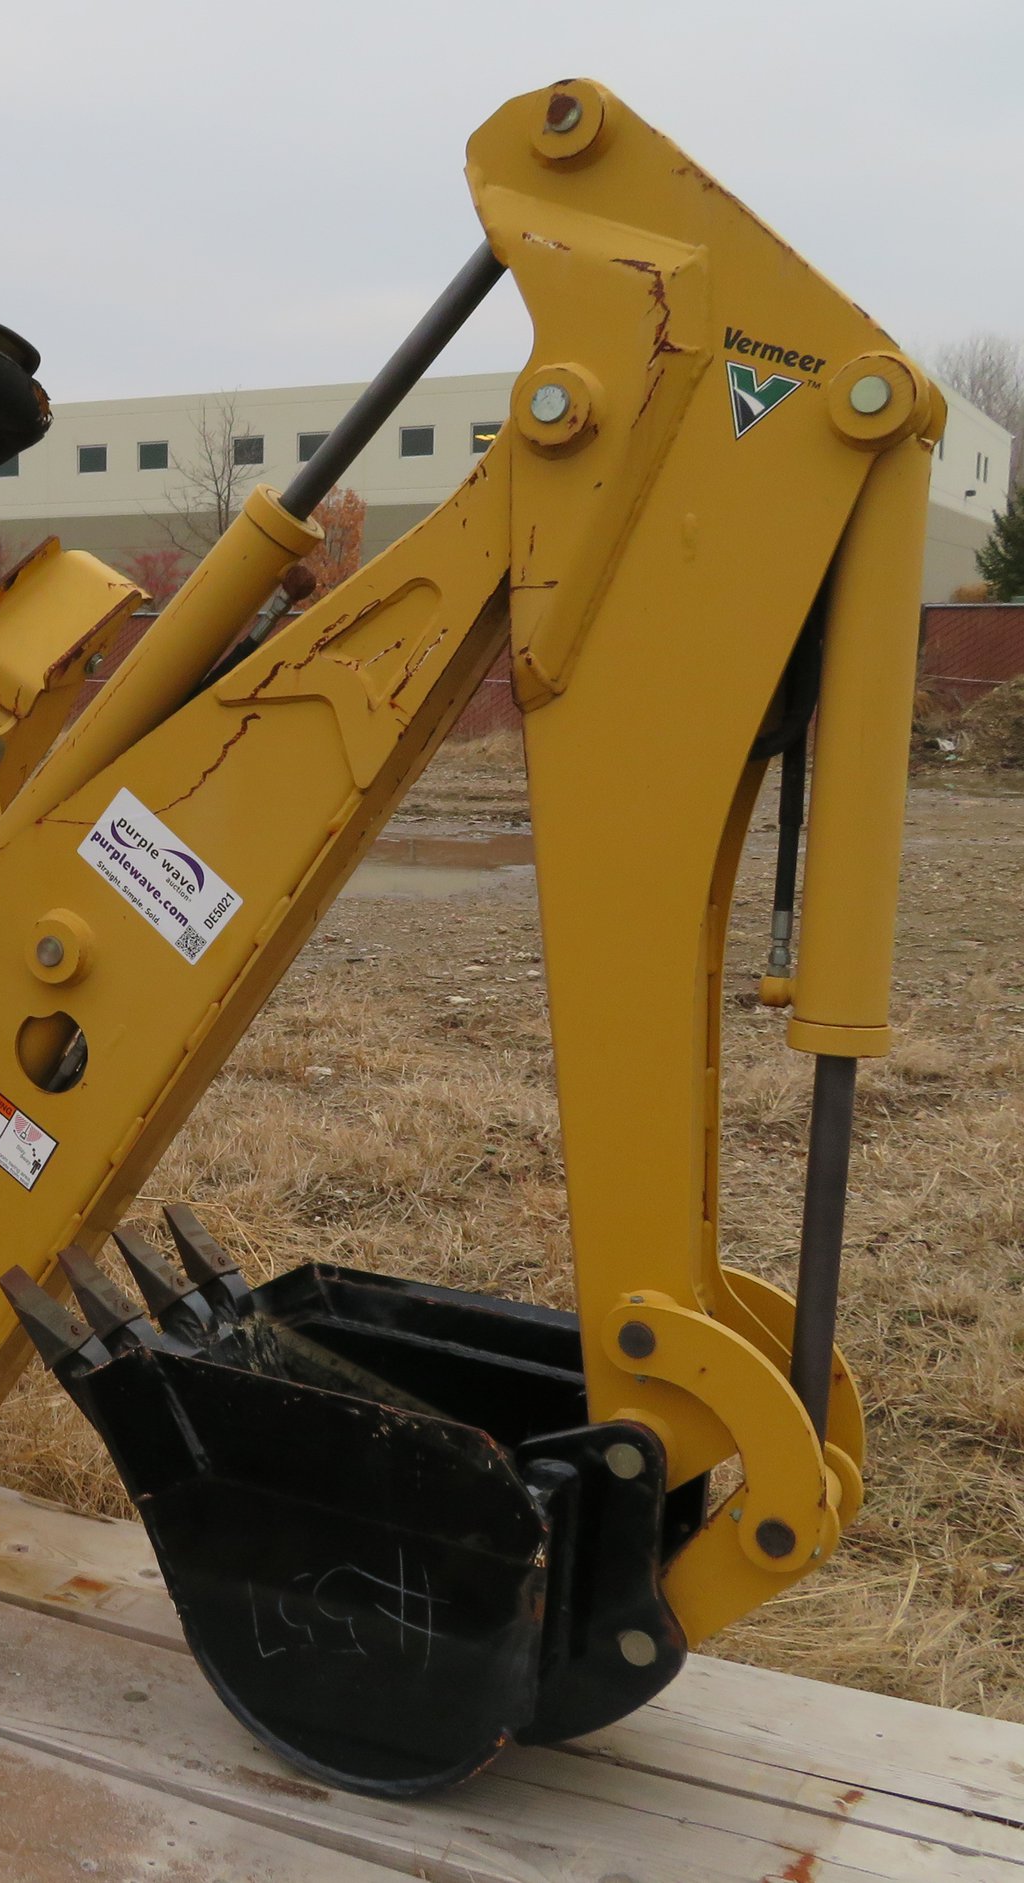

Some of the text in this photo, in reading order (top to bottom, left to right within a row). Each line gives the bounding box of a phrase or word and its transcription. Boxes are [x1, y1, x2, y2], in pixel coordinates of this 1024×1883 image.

[724, 326, 826, 373] Vermeer
[90, 830, 189, 928] purplewave.com
[96, 860, 122, 888] Straight.
[116, 817, 196, 895] purple wave
[203, 892, 235, 930] DE5021
